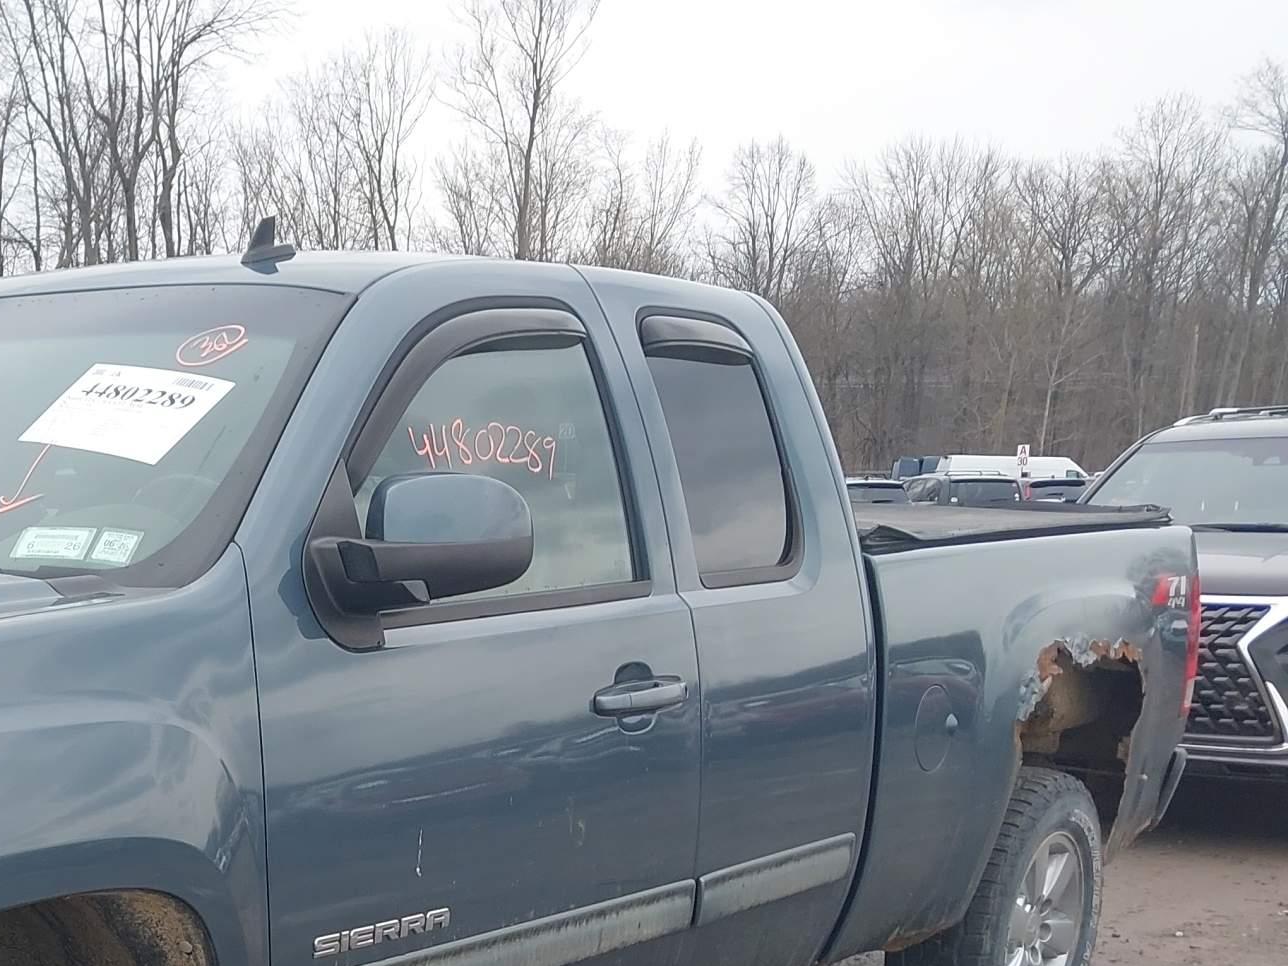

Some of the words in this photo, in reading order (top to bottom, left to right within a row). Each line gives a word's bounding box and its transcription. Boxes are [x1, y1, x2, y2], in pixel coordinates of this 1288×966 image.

[81, 382, 196, 410] 44802289
[408, 418, 556, 480] 44802289
[1017, 456, 1028, 466] 30
[1019, 445, 1027, 456] A
[313, 907, 450, 959] SIERRA
